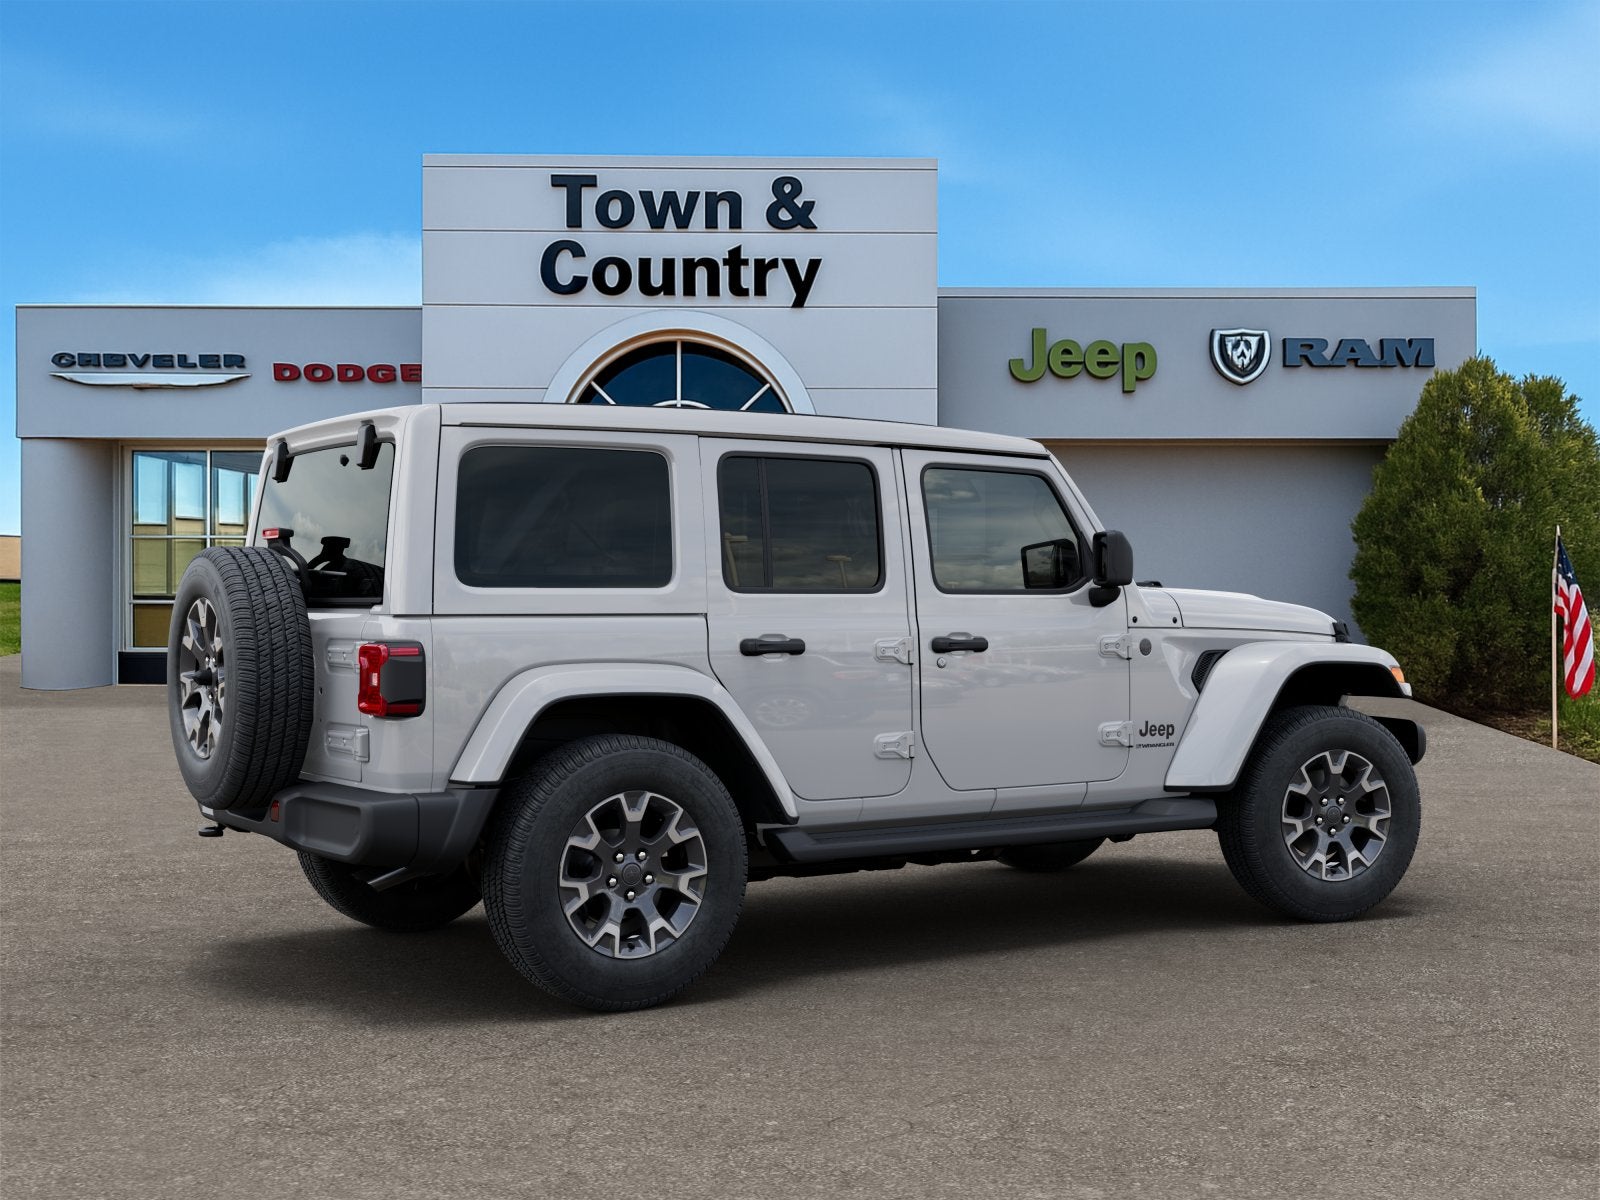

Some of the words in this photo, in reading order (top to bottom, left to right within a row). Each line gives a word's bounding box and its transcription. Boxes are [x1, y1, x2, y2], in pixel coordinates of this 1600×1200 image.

[550, 174, 743, 230] Town
[765, 176, 818, 230] &
[540, 239, 822, 308] Country
[273, 363, 422, 382] DODGE
[1009, 328, 1158, 393] Jeep
[1282, 338, 1435, 367] RAM
[1139, 720, 1175, 739] Jeep
